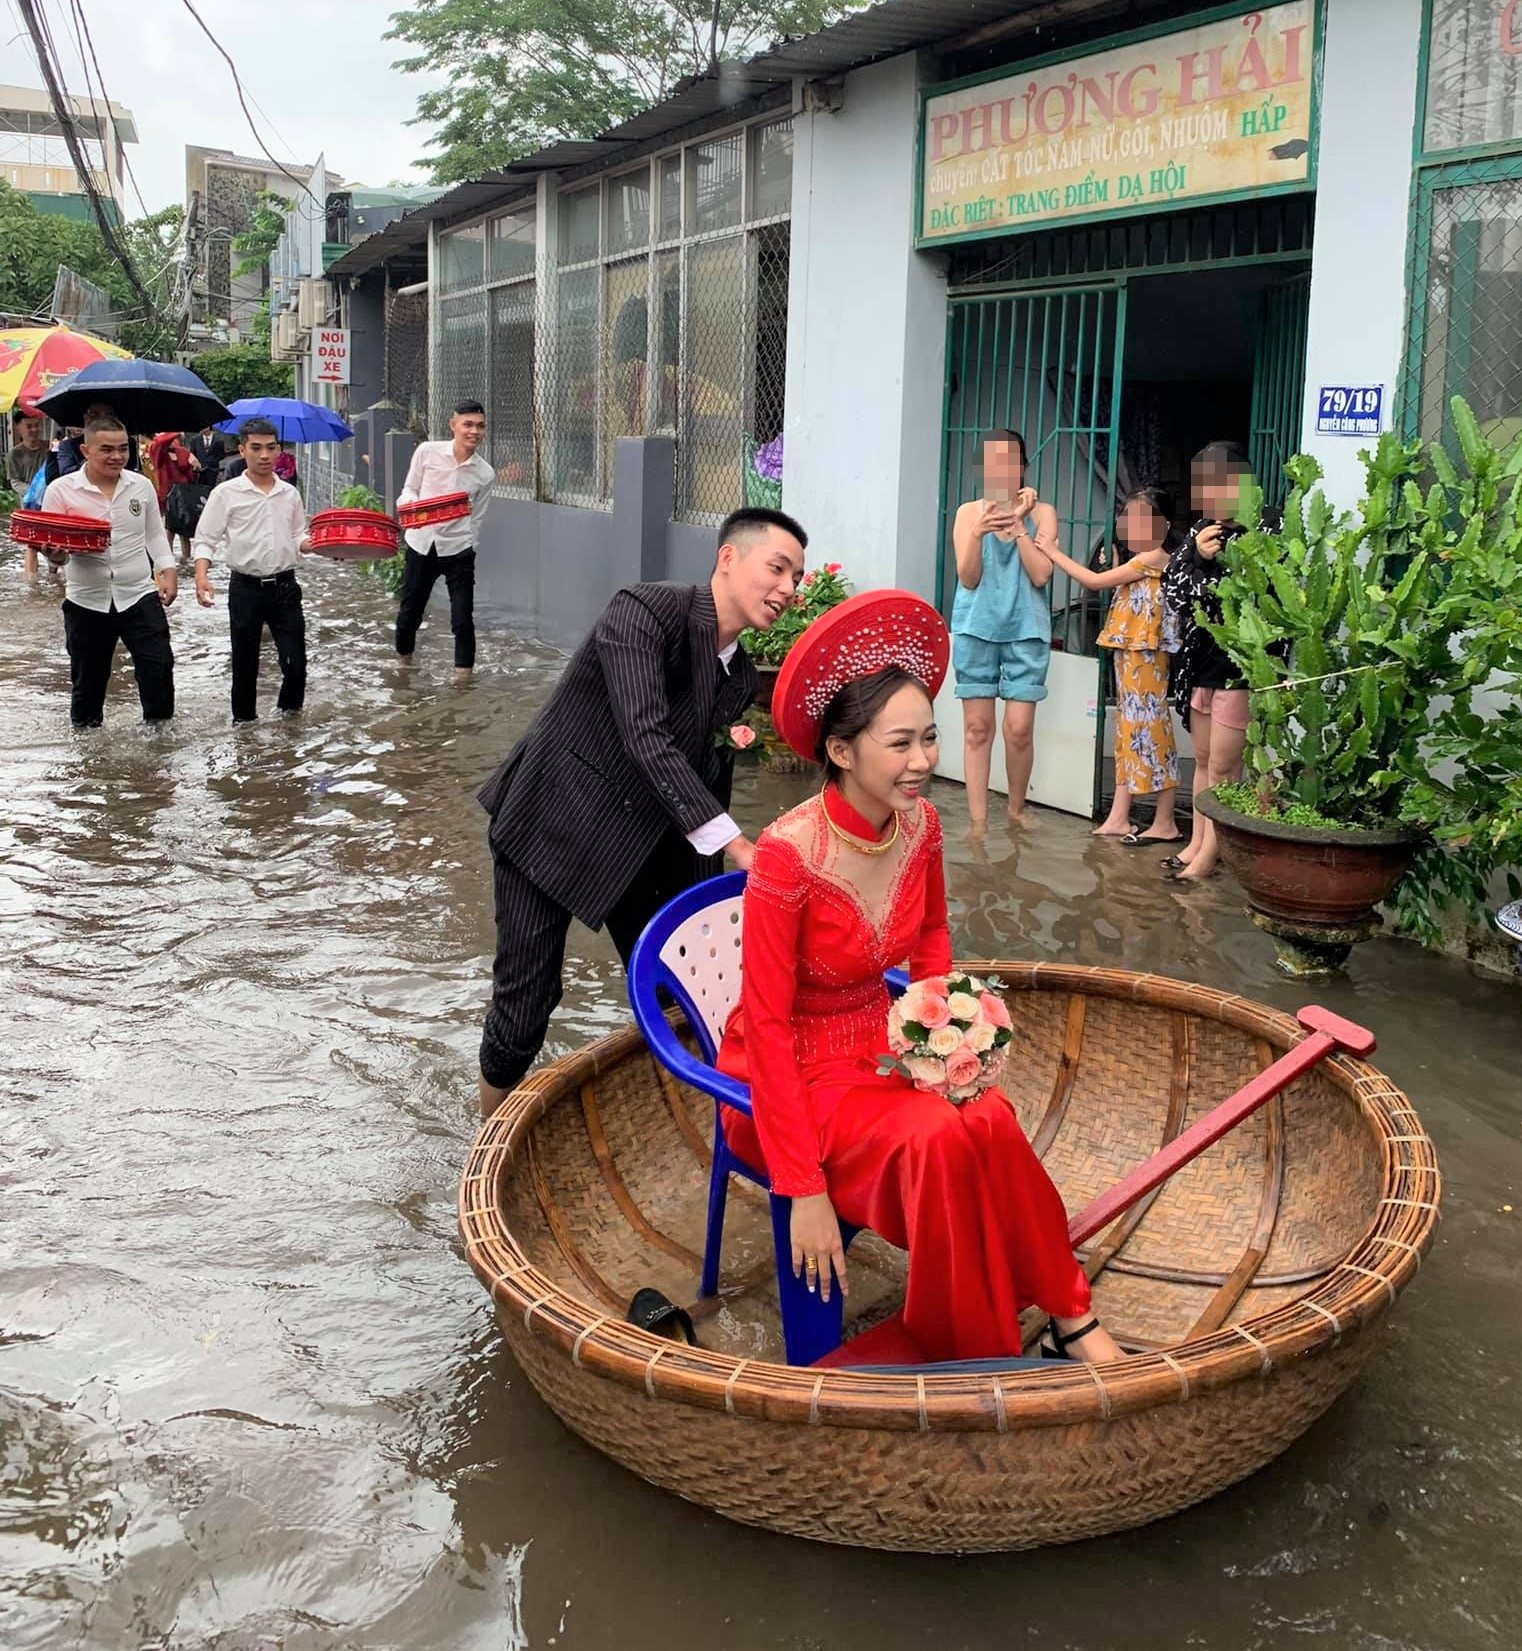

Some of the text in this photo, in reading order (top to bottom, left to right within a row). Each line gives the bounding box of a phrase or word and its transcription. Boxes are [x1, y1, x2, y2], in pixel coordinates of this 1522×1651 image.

[930, 14, 1307, 160] PHƯƠNG HẢI
[1015, 140, 1043, 179] TÓC
[1159, 105, 1229, 152] NHUỘM
[1240, 94, 1287, 137] HẤP
[930, 201, 960, 232] ĐẶC
[1007, 187, 1060, 217] TRANG
[1064, 169, 1109, 208] ĐIỂM
[1118, 175, 1143, 203] DẠ
[1149, 159, 1187, 199] HỘI
[318, 345, 346, 360] ĐẬU
[323, 361, 341, 372] XE
[1322, 389, 1378, 415] 79/19
